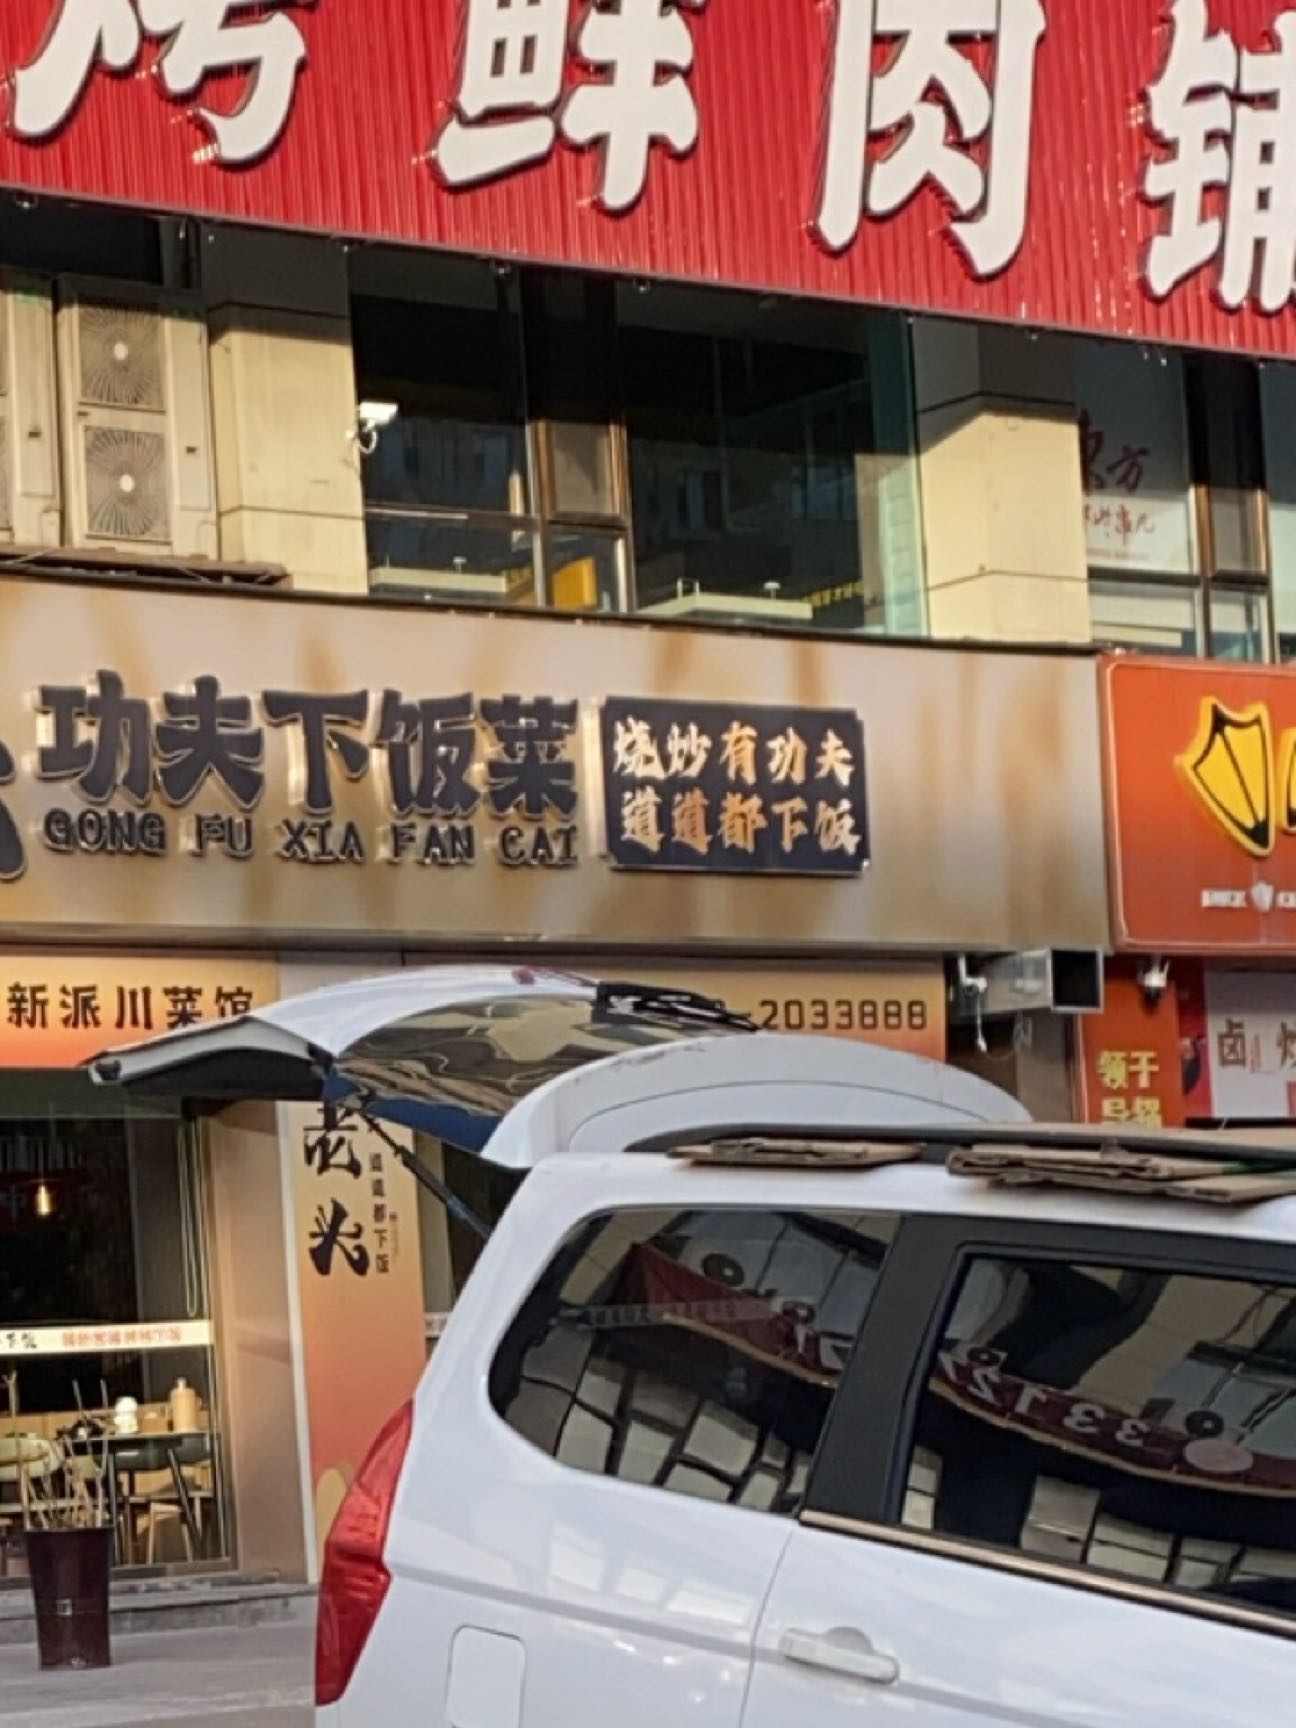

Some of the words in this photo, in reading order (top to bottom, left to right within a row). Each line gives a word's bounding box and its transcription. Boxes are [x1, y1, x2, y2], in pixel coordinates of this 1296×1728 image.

[38, 668, 580, 820] 功夫下饭菜
[613, 714, 856, 788] 烧炒有功夫
[42, 807, 168, 855] GONG
[192, 812, 256, 859] FU
[277, 818, 365, 863] XIA
[387, 820, 477, 866] FAN
[497, 824, 580, 867] CAI
[620, 784, 862, 856] 道道都下饭
[759, 999, 927, 1031] 2033888
